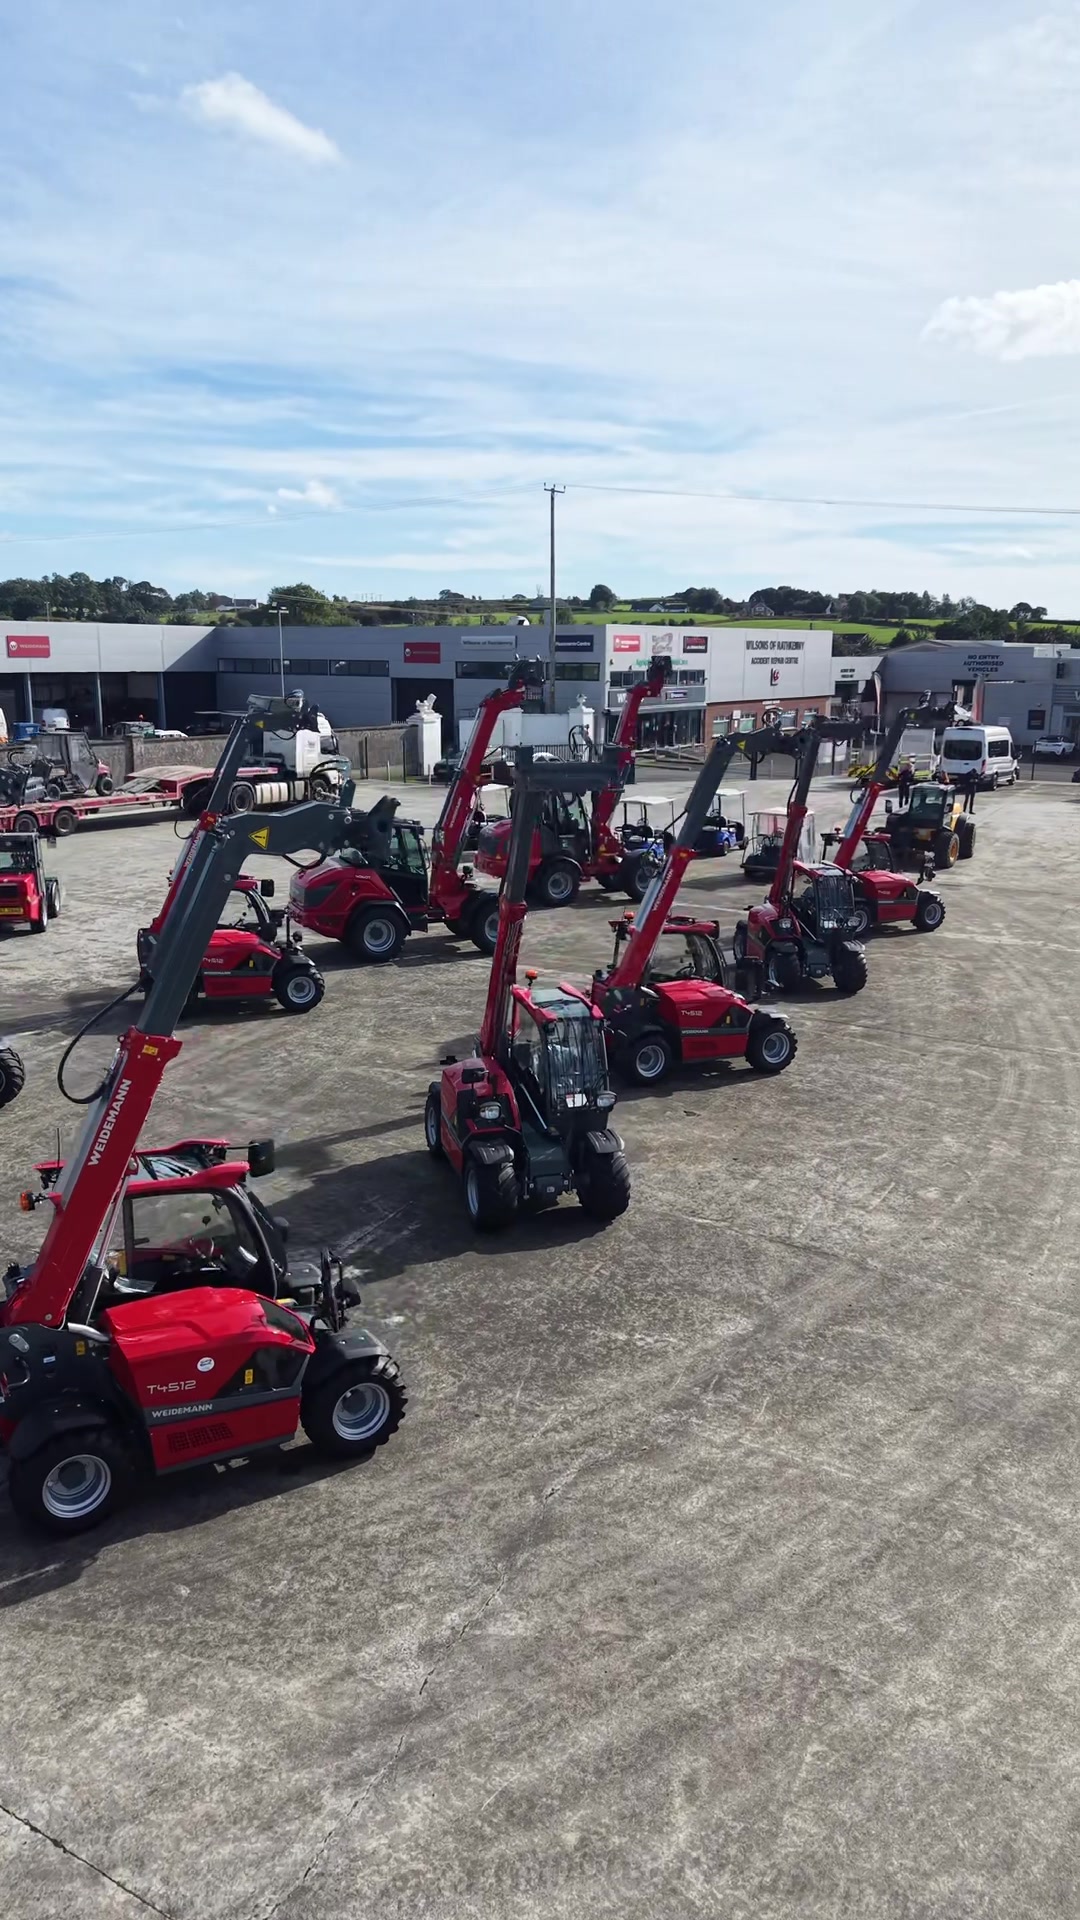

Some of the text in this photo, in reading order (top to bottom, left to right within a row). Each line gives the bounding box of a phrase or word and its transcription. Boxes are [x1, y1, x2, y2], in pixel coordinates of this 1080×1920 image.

[746, 640, 769, 650] WILSONS
[769, 640, 777, 650] OF
[87, 1078, 132, 1166] WEIDEMANN
[146, 1380, 197, 1395] T4512
[151, 1403, 213, 1418] WEIDEMANN
